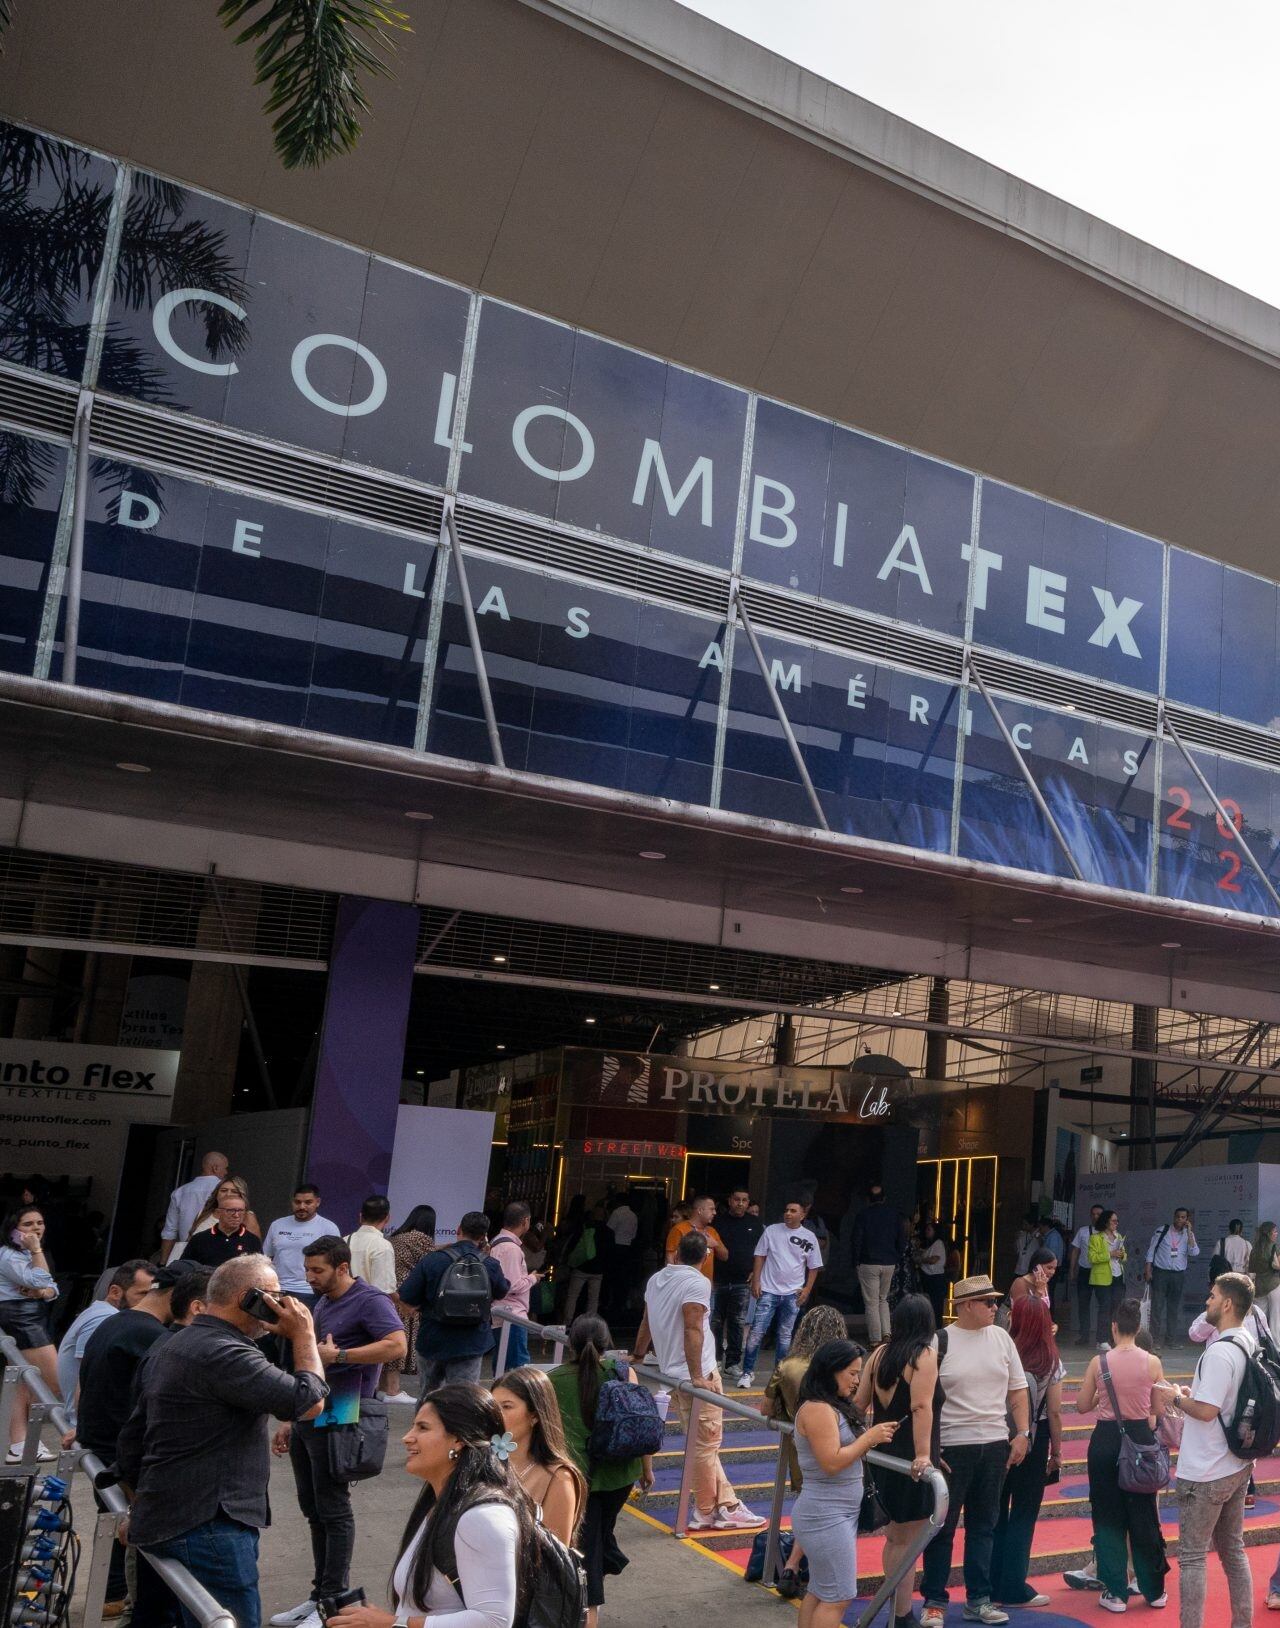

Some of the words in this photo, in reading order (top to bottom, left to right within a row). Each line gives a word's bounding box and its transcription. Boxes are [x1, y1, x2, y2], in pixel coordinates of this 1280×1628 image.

[152, 288, 1143, 659] COLOMBIATEX
[117, 491, 264, 558] DE
[402, 562, 591, 639] LAS
[698, 641, 1139, 776] AMÉRICAS
[0, 1059, 70, 1086] nto
[83, 1063, 156, 1091] flex
[7, 1087, 97, 1101] TEXTILES
[661, 1066, 849, 1113] PROTELA
